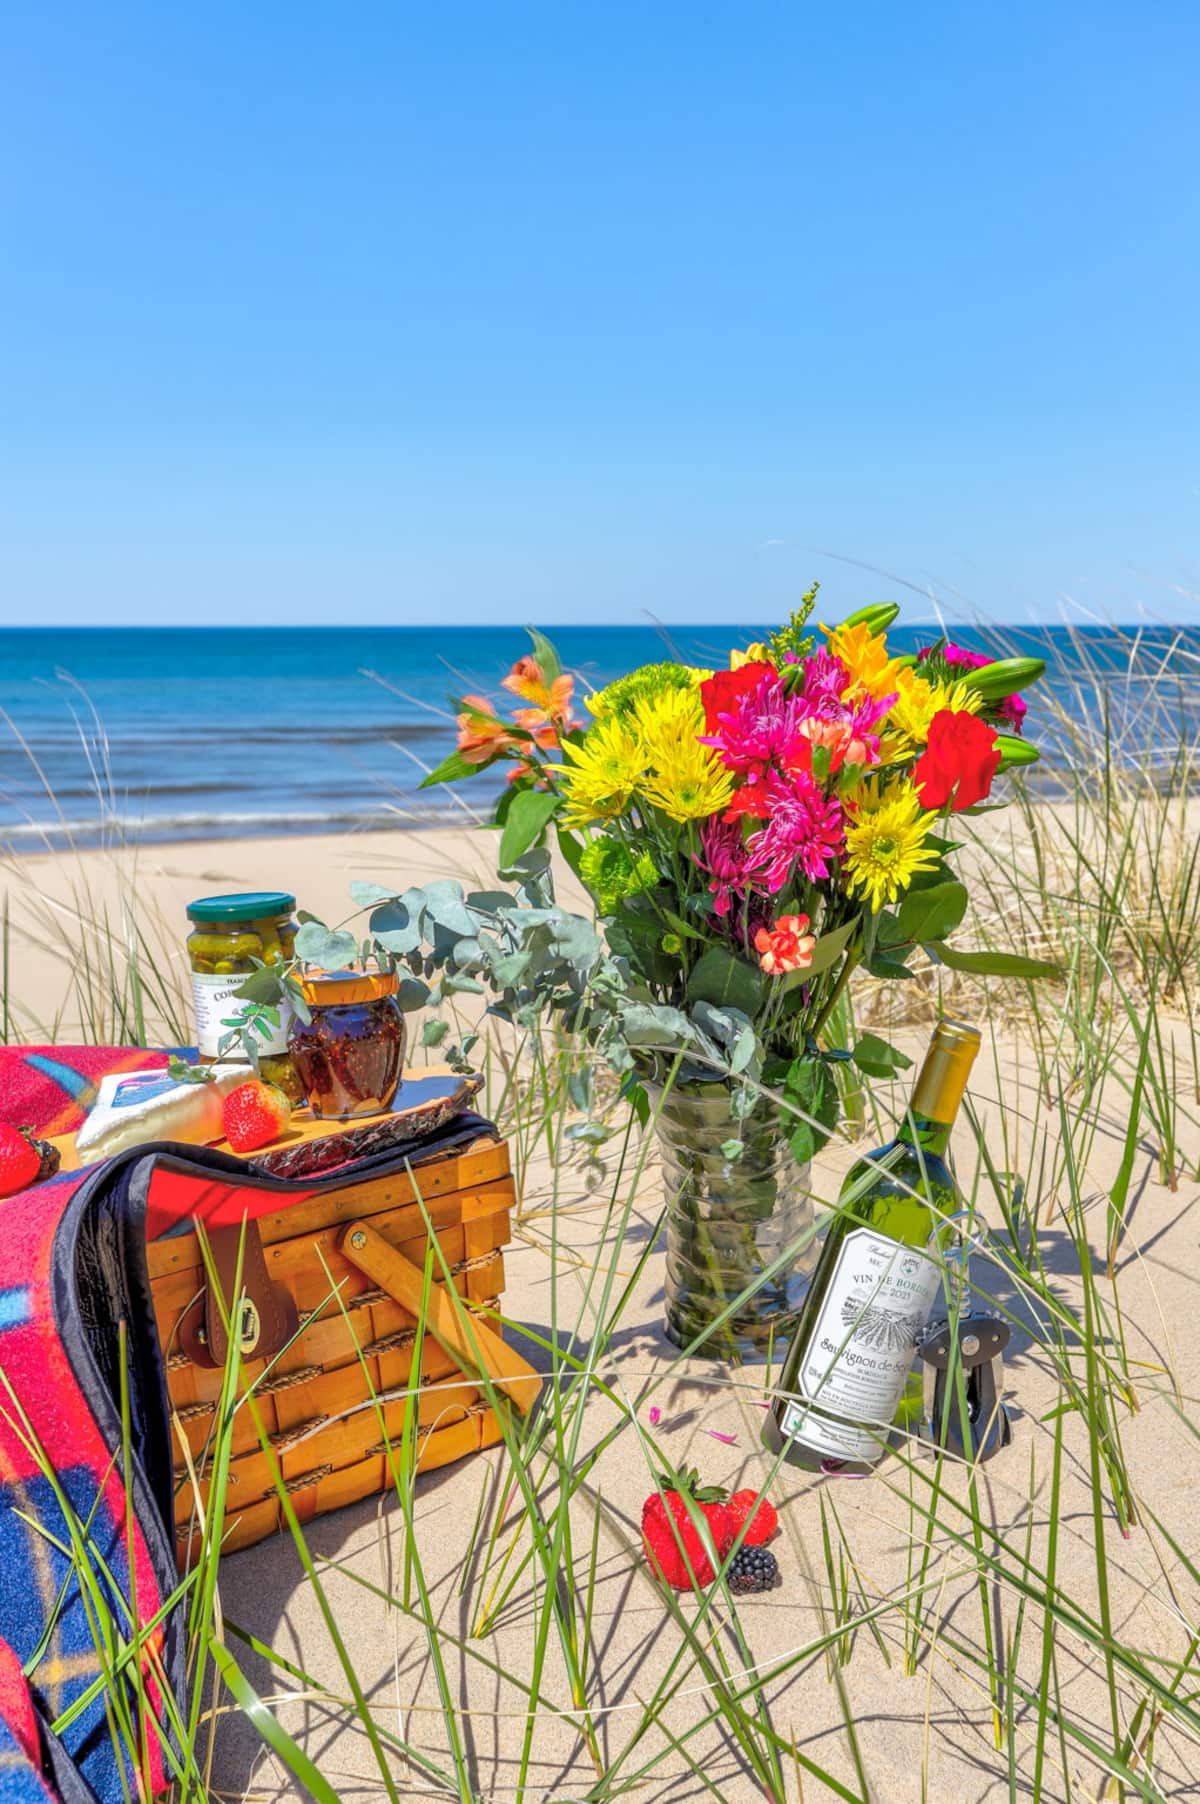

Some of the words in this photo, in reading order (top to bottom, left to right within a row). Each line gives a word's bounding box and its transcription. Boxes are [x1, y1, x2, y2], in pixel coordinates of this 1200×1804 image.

[853, 1274, 873, 1283] VIN
[889, 1288, 911, 1300] 2021
[820, 1337, 877, 1369] Sauvignon
[878, 1360, 893, 1372] de
